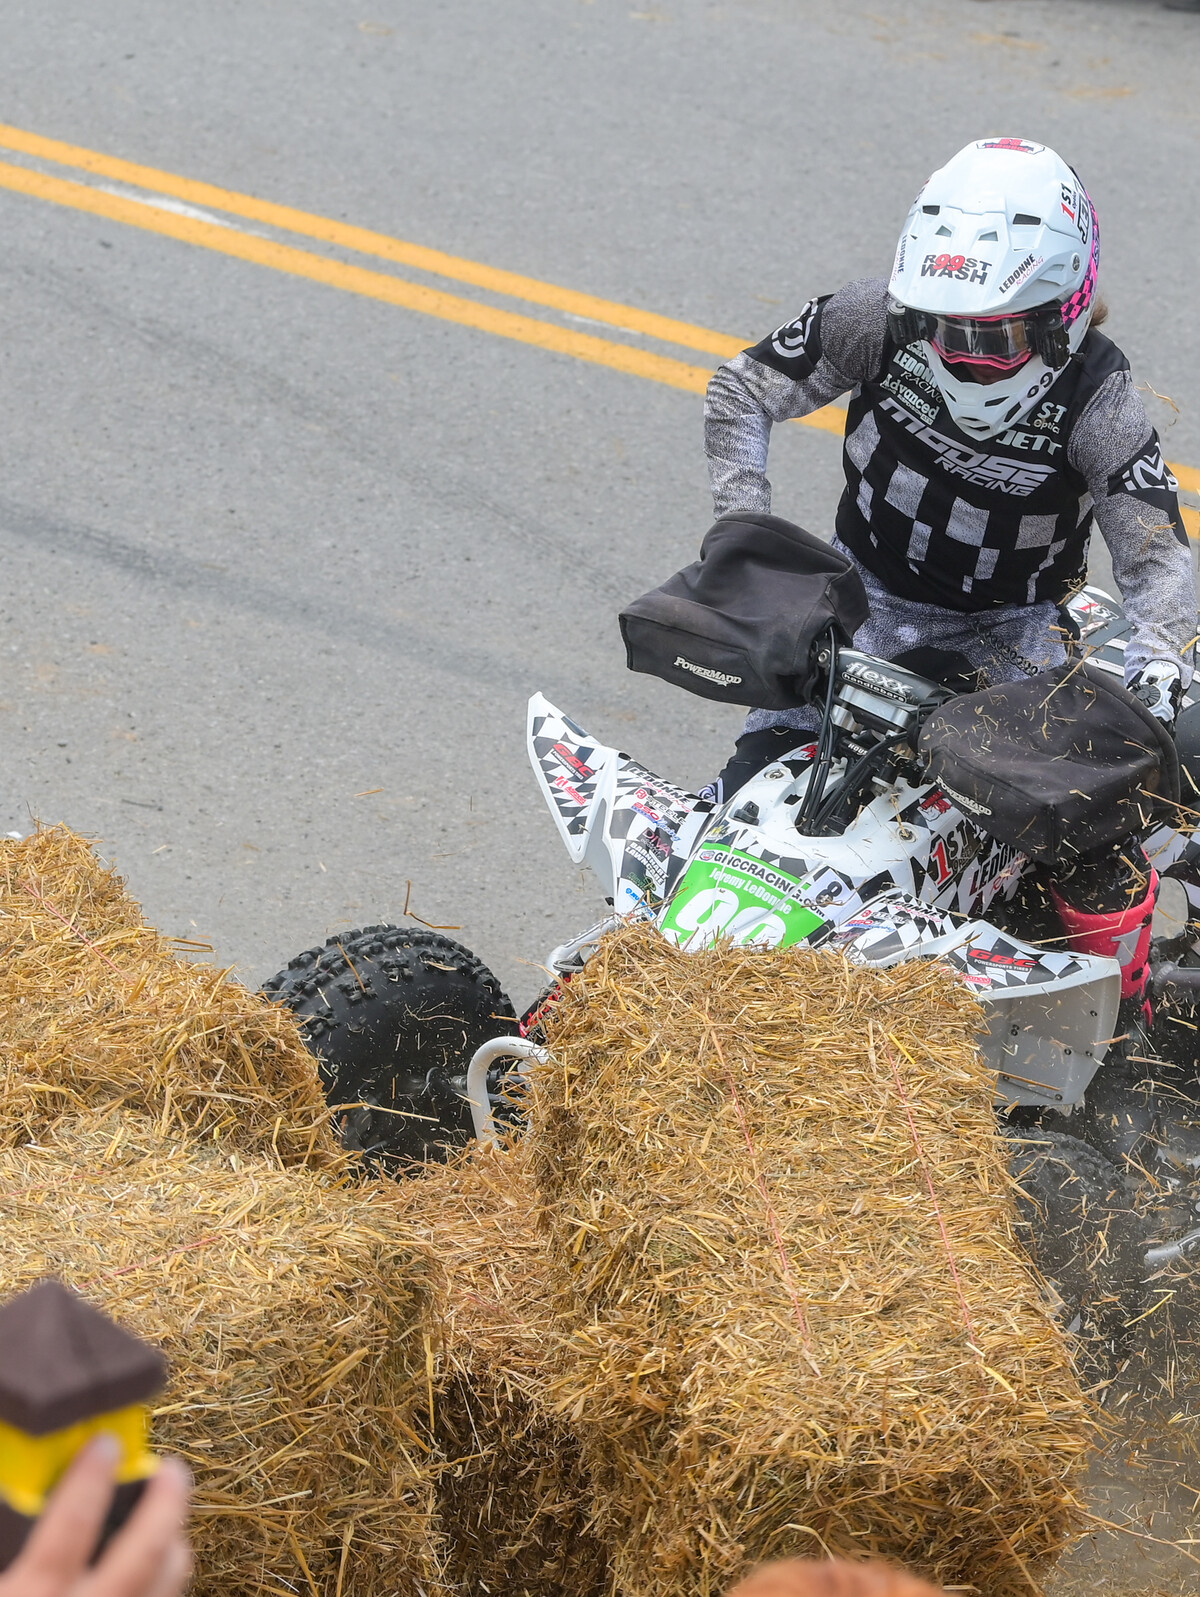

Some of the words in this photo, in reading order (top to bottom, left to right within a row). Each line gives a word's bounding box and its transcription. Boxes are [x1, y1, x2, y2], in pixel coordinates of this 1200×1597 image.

[920, 264, 989, 285] WASH
[999, 254, 1036, 294] LEDONNE
[1015, 255, 1045, 286] RACING
[879, 373, 940, 420] Advanced
[900, 371, 944, 403] RACING
[996, 430, 1063, 456] JETT
[933, 456, 1036, 497] RACING
[843, 673, 906, 702] handlebars
[846, 661, 913, 697] flexx
[553, 743, 596, 777] GBC
[627, 766, 691, 804] LEDONNE
[708, 867, 746, 889] Jeremy
[968, 949, 1040, 968] GBC
[974, 958, 1013, 970] POWERSPORTS
